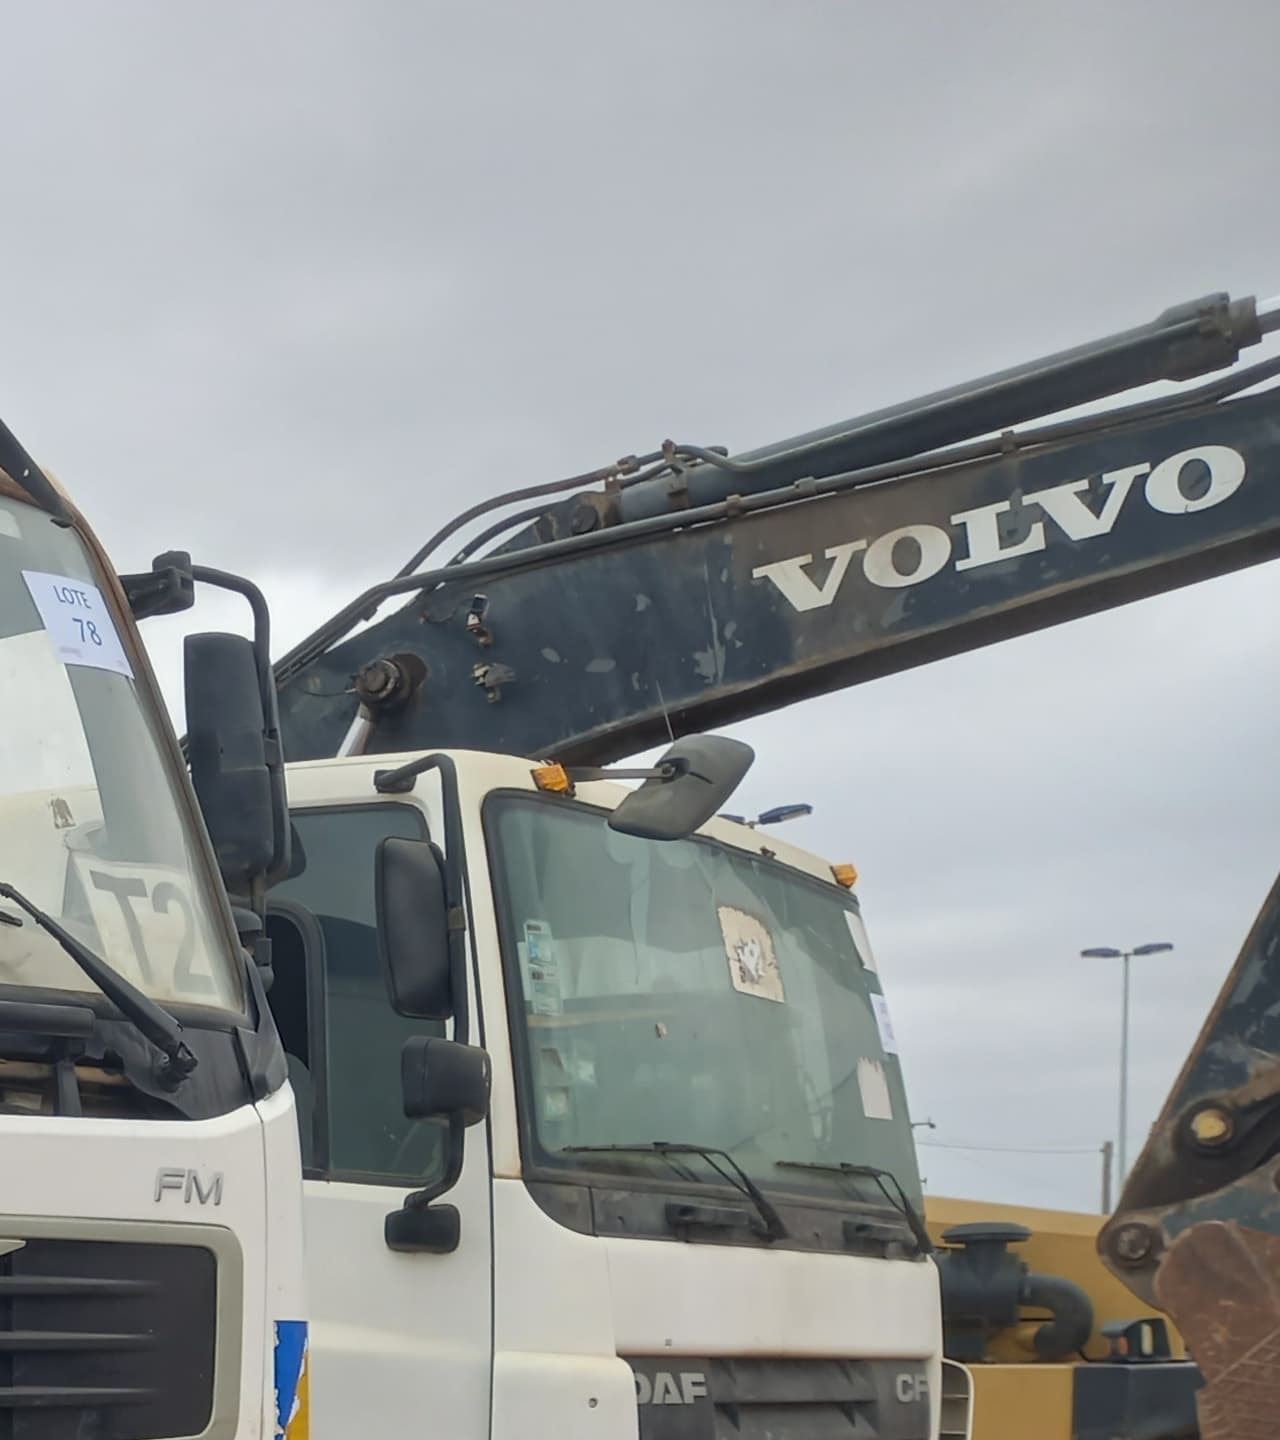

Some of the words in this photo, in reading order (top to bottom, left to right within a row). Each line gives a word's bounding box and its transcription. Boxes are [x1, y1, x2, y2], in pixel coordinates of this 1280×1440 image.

[752, 445, 1246, 612] VOLVO
[53, 585, 92, 609] LOTE
[71, 617, 102, 646] 78
[154, 1166, 225, 1206] FM
[634, 1372, 708, 1404] DAF
[896, 1373, 929, 1402] CF
